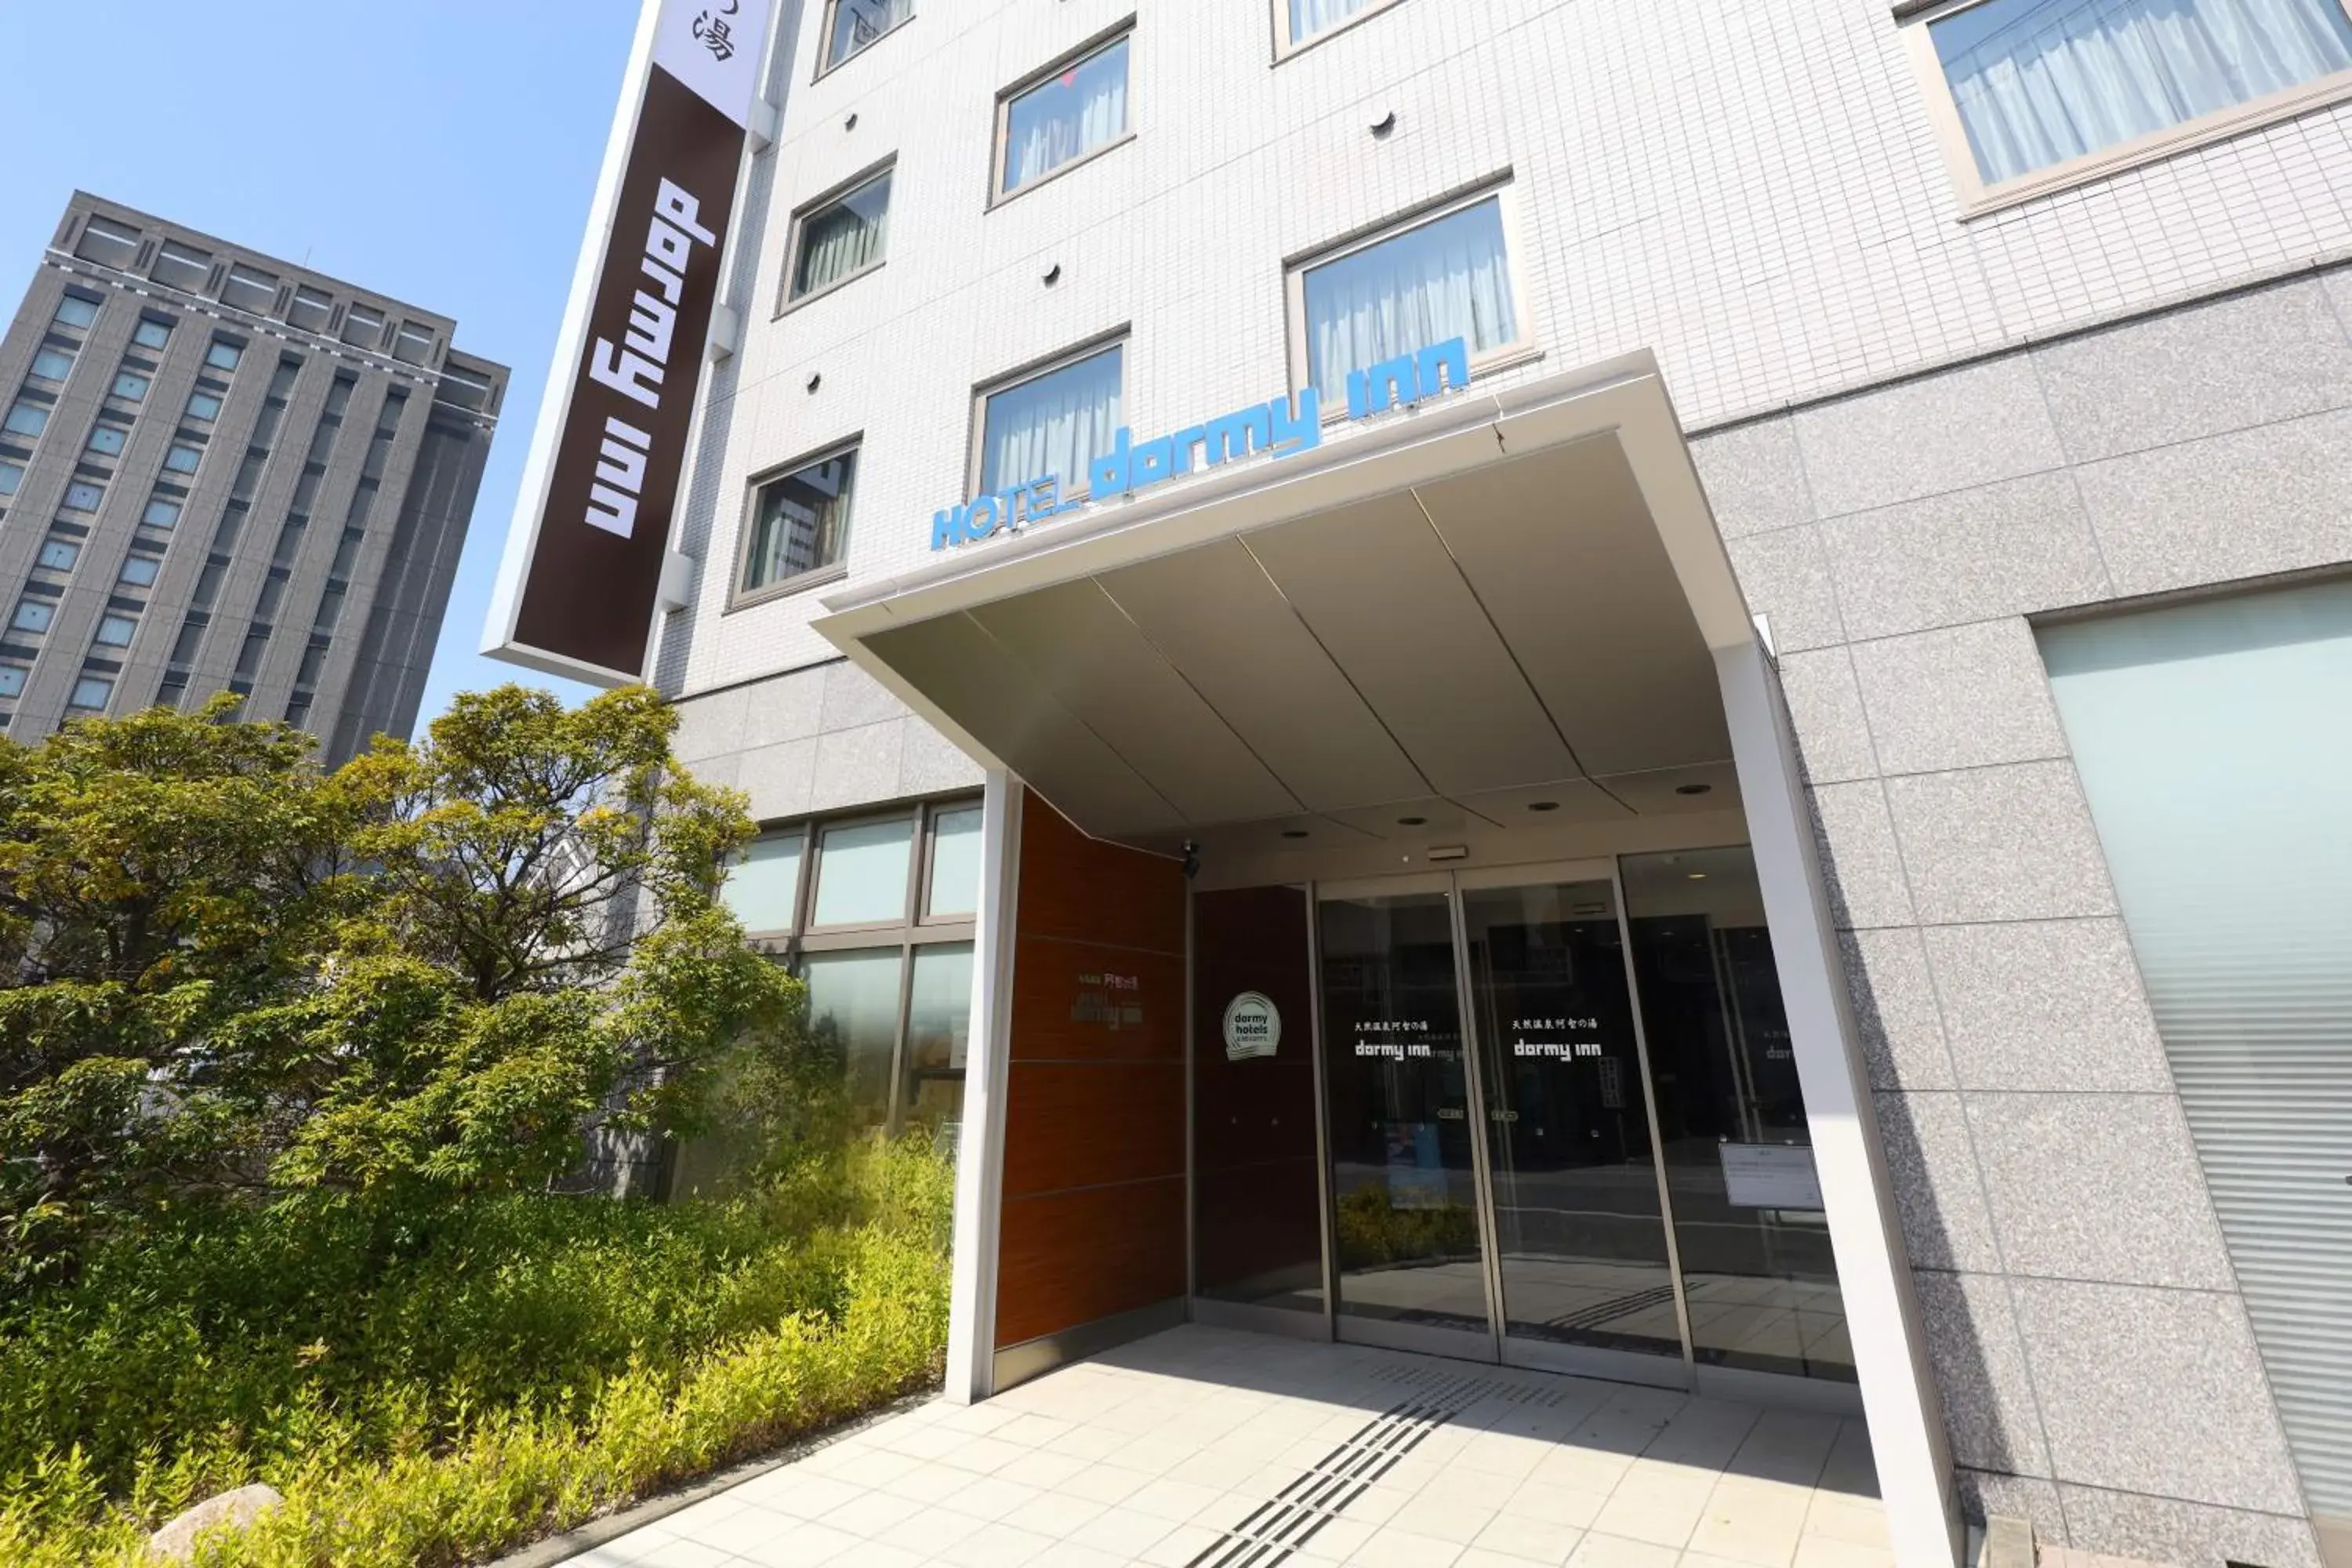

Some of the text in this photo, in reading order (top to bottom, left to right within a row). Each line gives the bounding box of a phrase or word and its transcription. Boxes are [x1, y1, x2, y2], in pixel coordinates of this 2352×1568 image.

[584, 176, 715, 539] dormy inn
[931, 336, 1471, 550] HOTEL dormy inn
[1235, 1012, 1268, 1024] dormy
[1236, 1024, 1268, 1034] hotels
[1355, 1039, 1431, 1061] dormy inn
[1514, 1038, 1602, 1062] dormy inn
